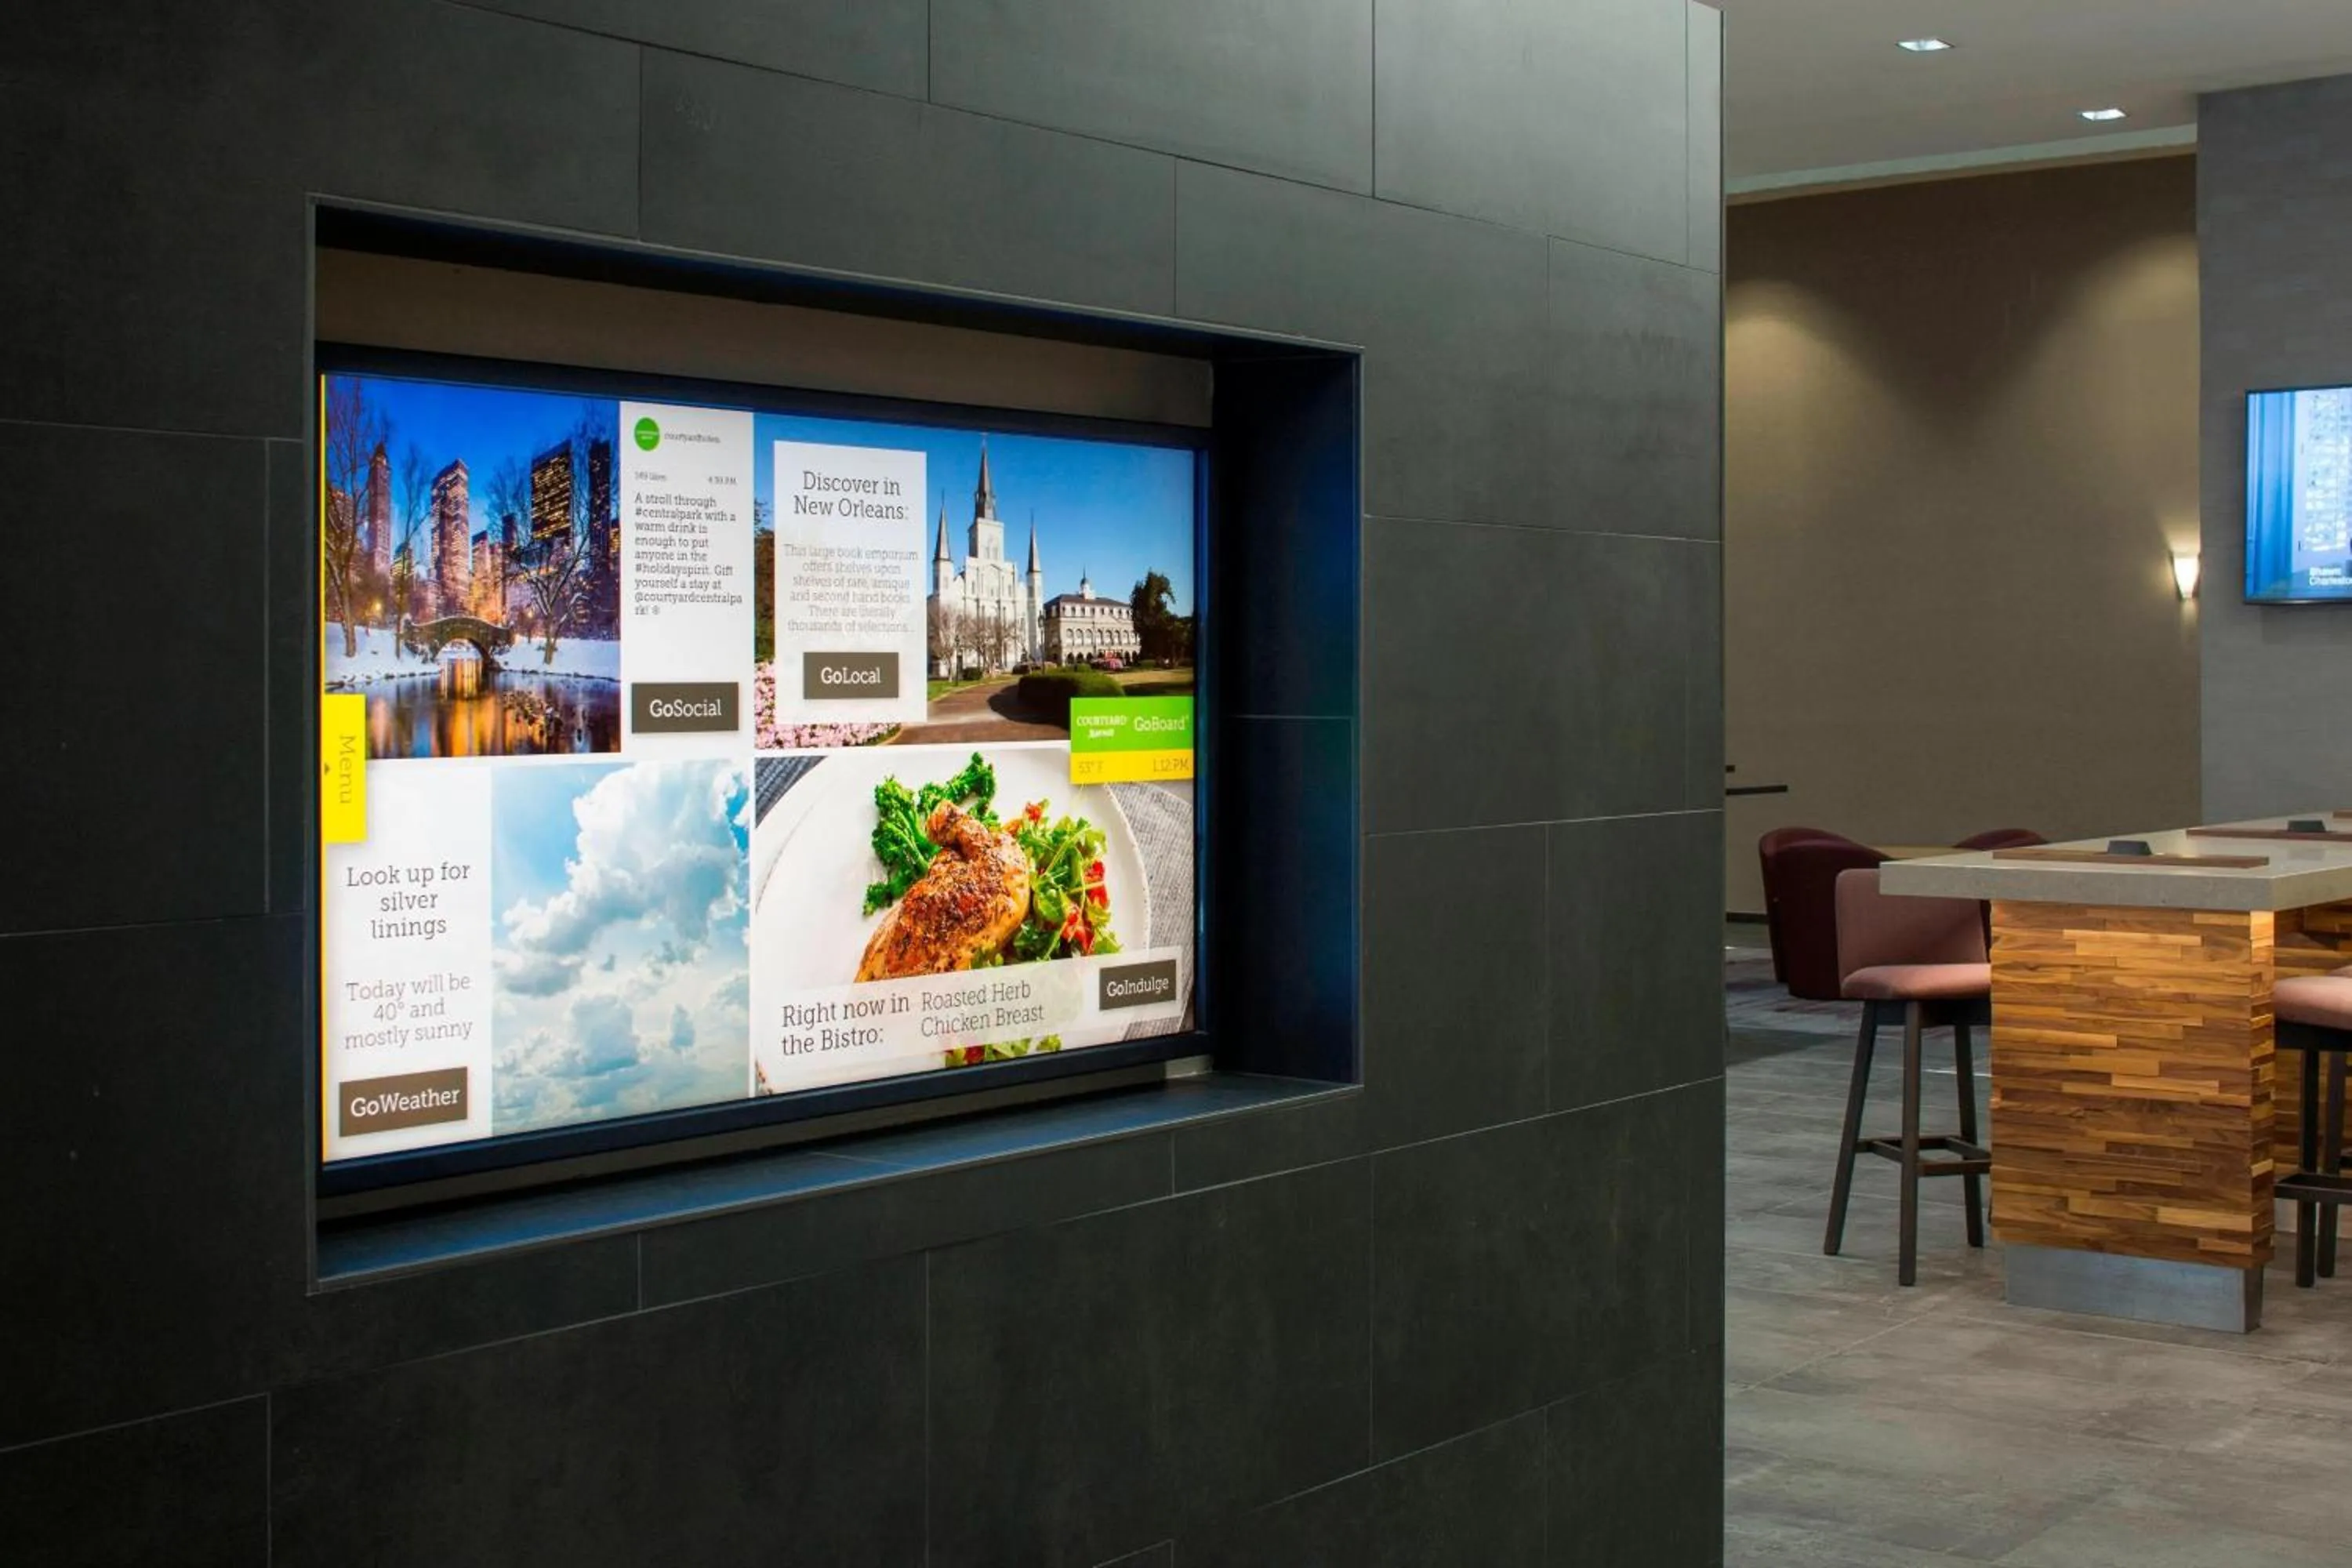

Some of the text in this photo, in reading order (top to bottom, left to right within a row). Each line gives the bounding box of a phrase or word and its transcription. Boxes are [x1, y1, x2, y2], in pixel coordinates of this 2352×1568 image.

[803, 470, 901, 495] Discover in
[635, 492, 717, 509] A stroll through
[793, 495, 909, 521] New Orleans:
[635, 506, 736, 521] #centralpark with a
[635, 521, 708, 534] warm drink is
[635, 535, 709, 548] enough to put
[635, 550, 707, 561] anyone in the
[714, 564, 733, 576] Gift
[634, 578, 677, 590] yourself
[690, 580, 710, 591] stay
[712, 580, 721, 590] at
[789, 590, 810, 601] and
[821, 666, 881, 685] GoLocal
[650, 699, 722, 718] GoSocial
[339, 735, 356, 804] Menu
[347, 861, 470, 887] Look up for
[380, 891, 438, 912] silver
[371, 918, 447, 940] linings
[346, 973, 470, 1001] Today will be
[922, 979, 1032, 1011] Roasted Herb
[1106, 975, 1170, 997] GoIndulge
[373, 998, 445, 1022] 40° and
[782, 993, 910, 1029] Right now in
[921, 1004, 1045, 1038] Chicken Breast
[345, 1022, 473, 1050] mostly sunny
[782, 1026, 884, 1056] the Bistro:
[350, 1088, 460, 1117] GoWeather
